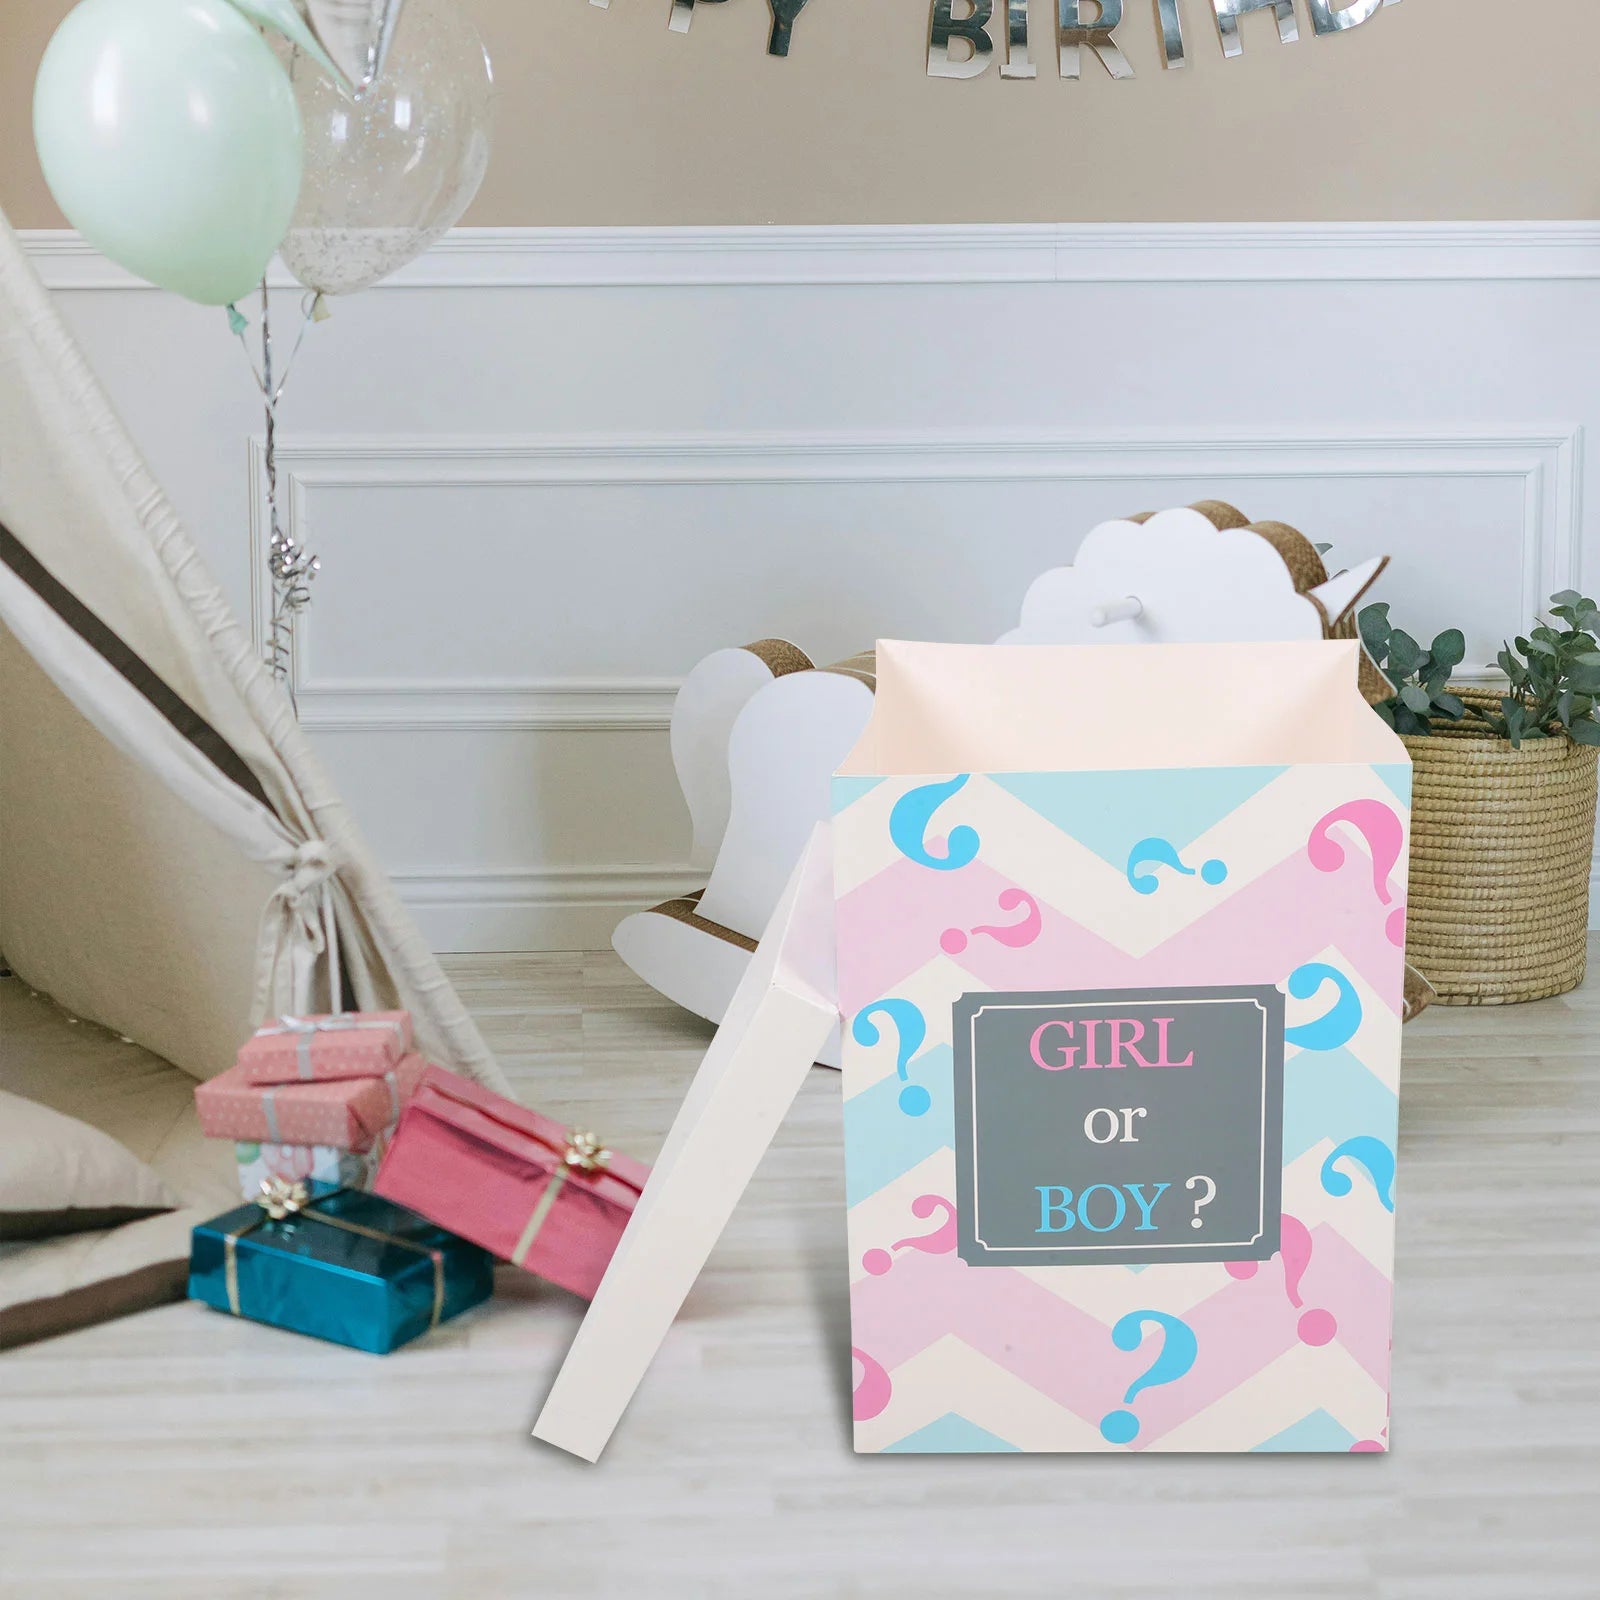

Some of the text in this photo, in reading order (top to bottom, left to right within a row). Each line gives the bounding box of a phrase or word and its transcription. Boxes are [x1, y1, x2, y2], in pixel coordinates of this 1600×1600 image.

[1029, 1017, 1194, 1071] GIRL
[1083, 1106, 1148, 1144] or
[1034, 1183, 1172, 1233] BOY
